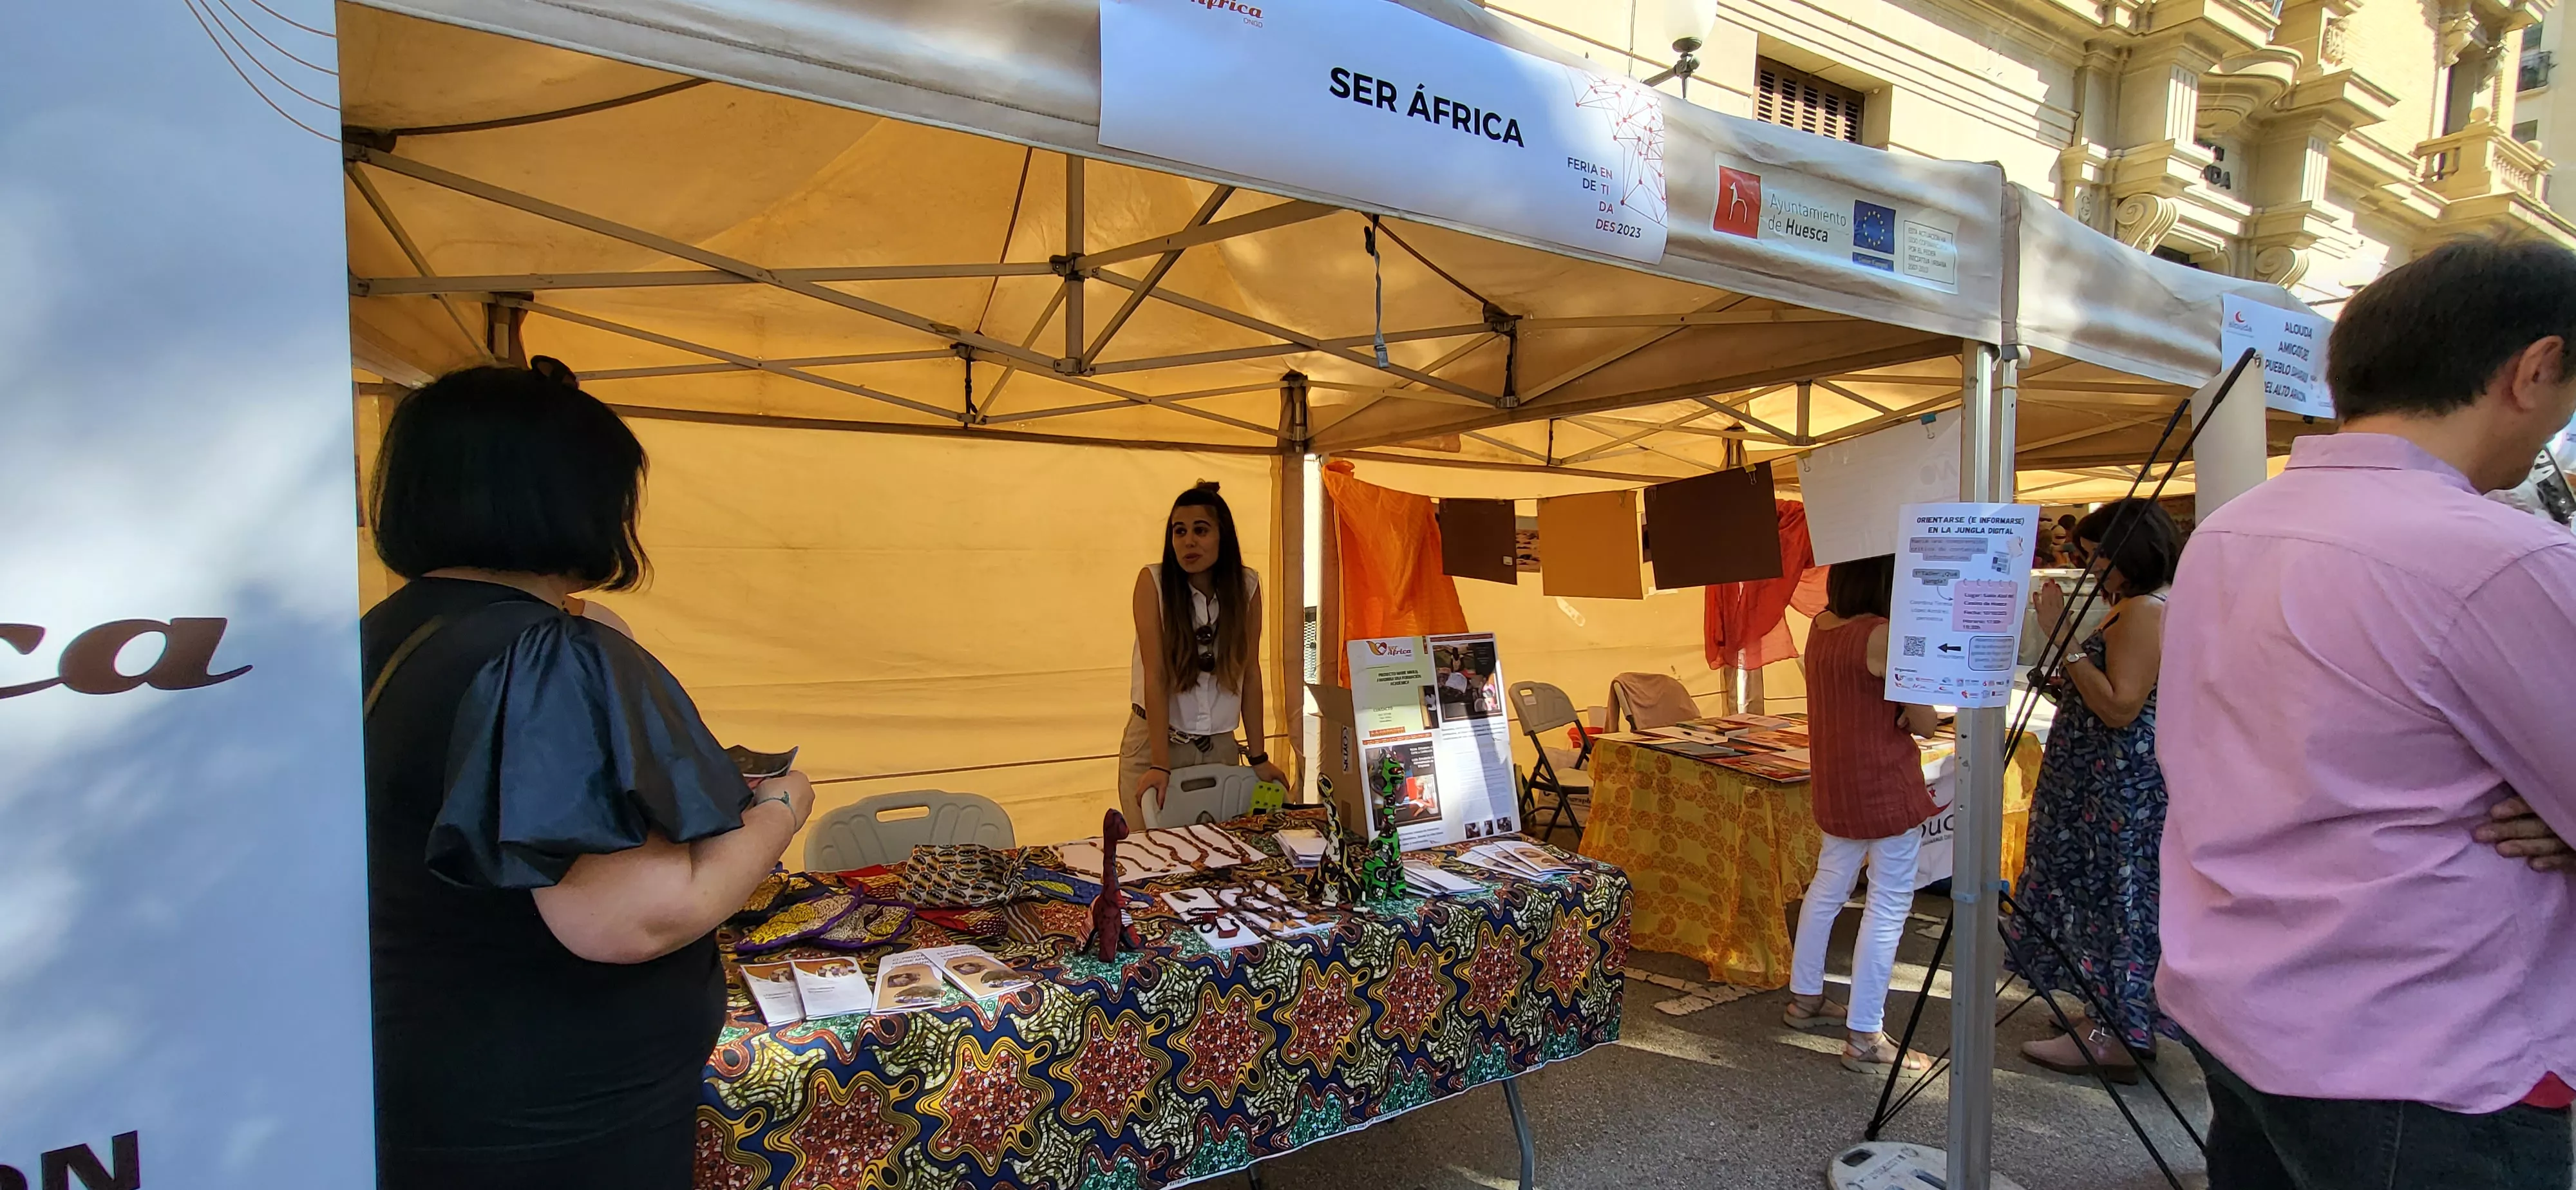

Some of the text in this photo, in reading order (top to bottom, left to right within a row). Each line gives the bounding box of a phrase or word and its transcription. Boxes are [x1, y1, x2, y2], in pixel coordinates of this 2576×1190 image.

[1243, 17, 1263, 28] ONGD
[1329, 66, 1525, 147] SER ÁFRICA
[1567, 156, 1613, 180] FERIA EN
[1582, 178, 1609, 195] DE TI
[1599, 201, 1614, 214] DA
[1770, 193, 1846, 227] Ayuntamiento
[1596, 218, 1642, 238] DES 2023
[1768, 216, 1828, 243] de Huesca
[2284, 321, 2313, 340] ALOUDA
[2265, 359, 2291, 375] PUEBLO
[2264, 381, 2273, 394] EL
[2274, 384, 2290, 397] ALTO
[1967, 516, 1976, 525] (E
[1979, 517, 2025, 525] INFORMARSE)
